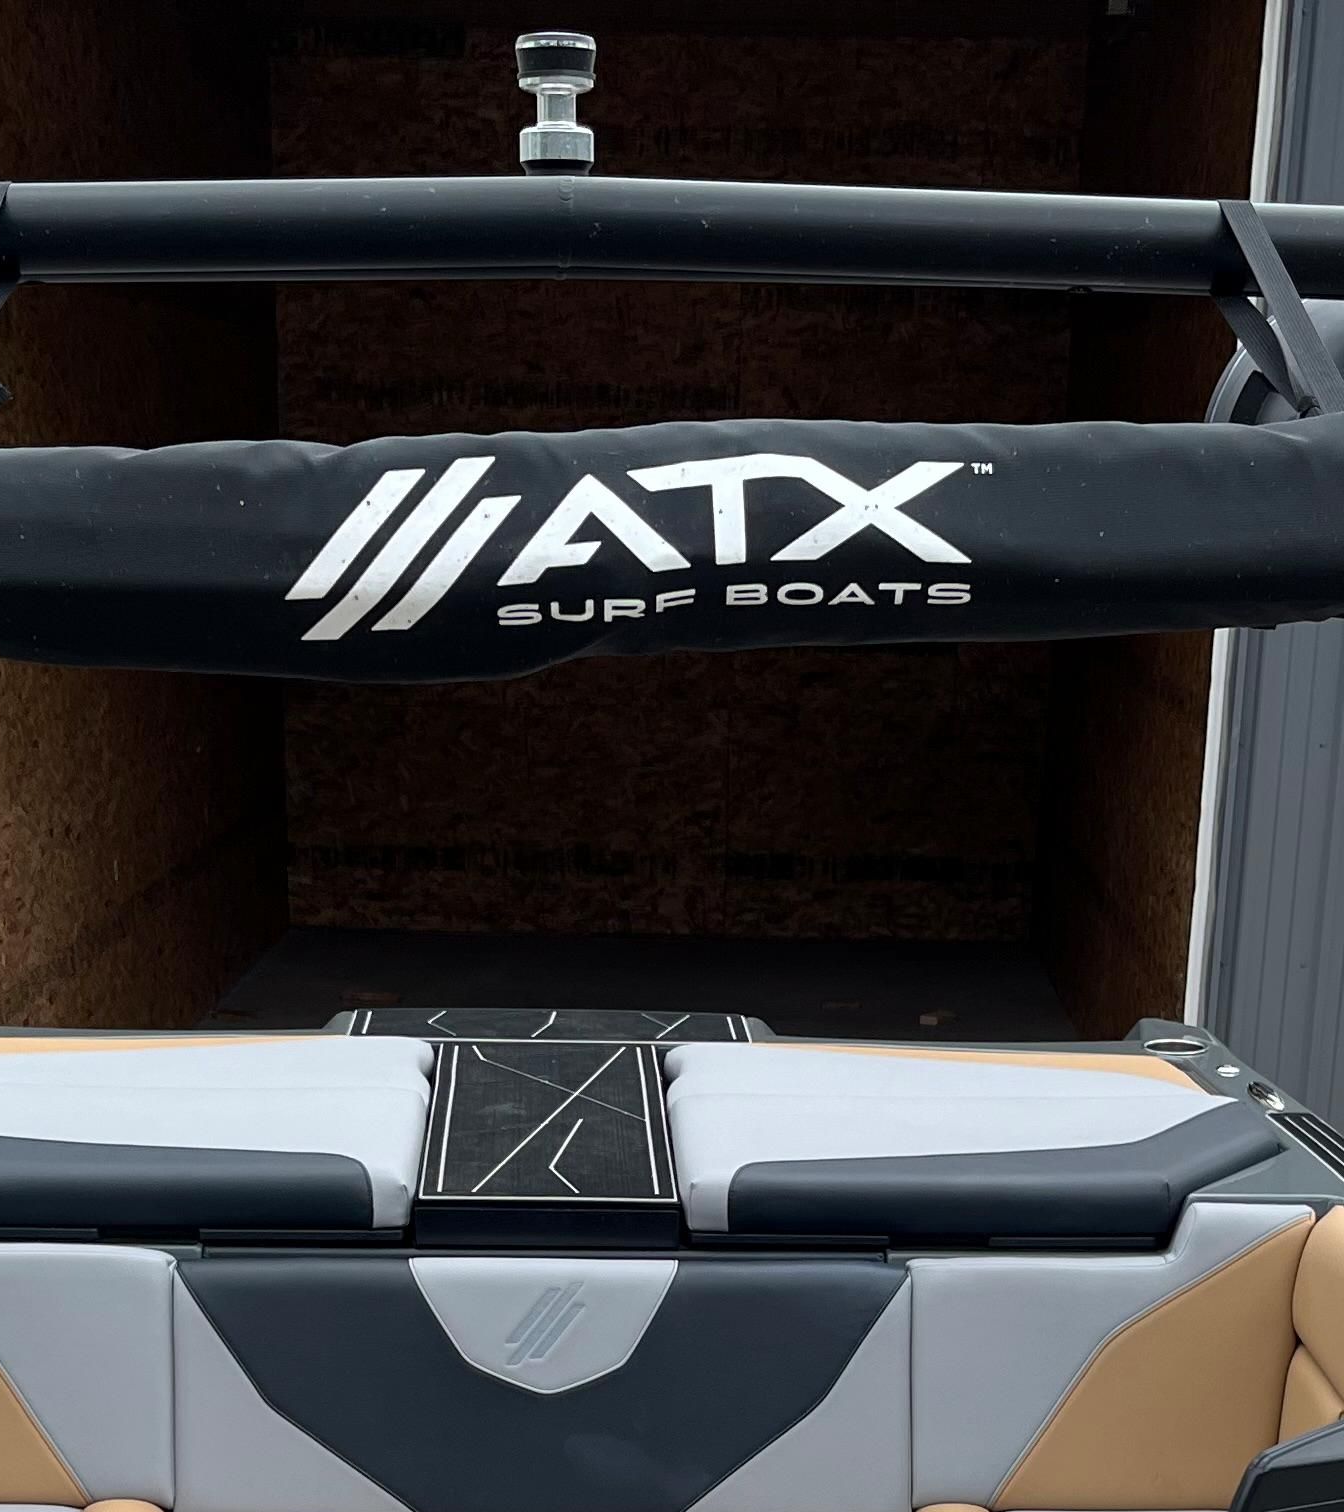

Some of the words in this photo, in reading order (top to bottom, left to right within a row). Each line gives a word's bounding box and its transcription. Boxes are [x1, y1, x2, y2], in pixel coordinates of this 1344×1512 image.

[498, 453, 972, 586] ATX
[498, 589, 695, 626] SURF
[726, 582, 972, 606] BOATS
